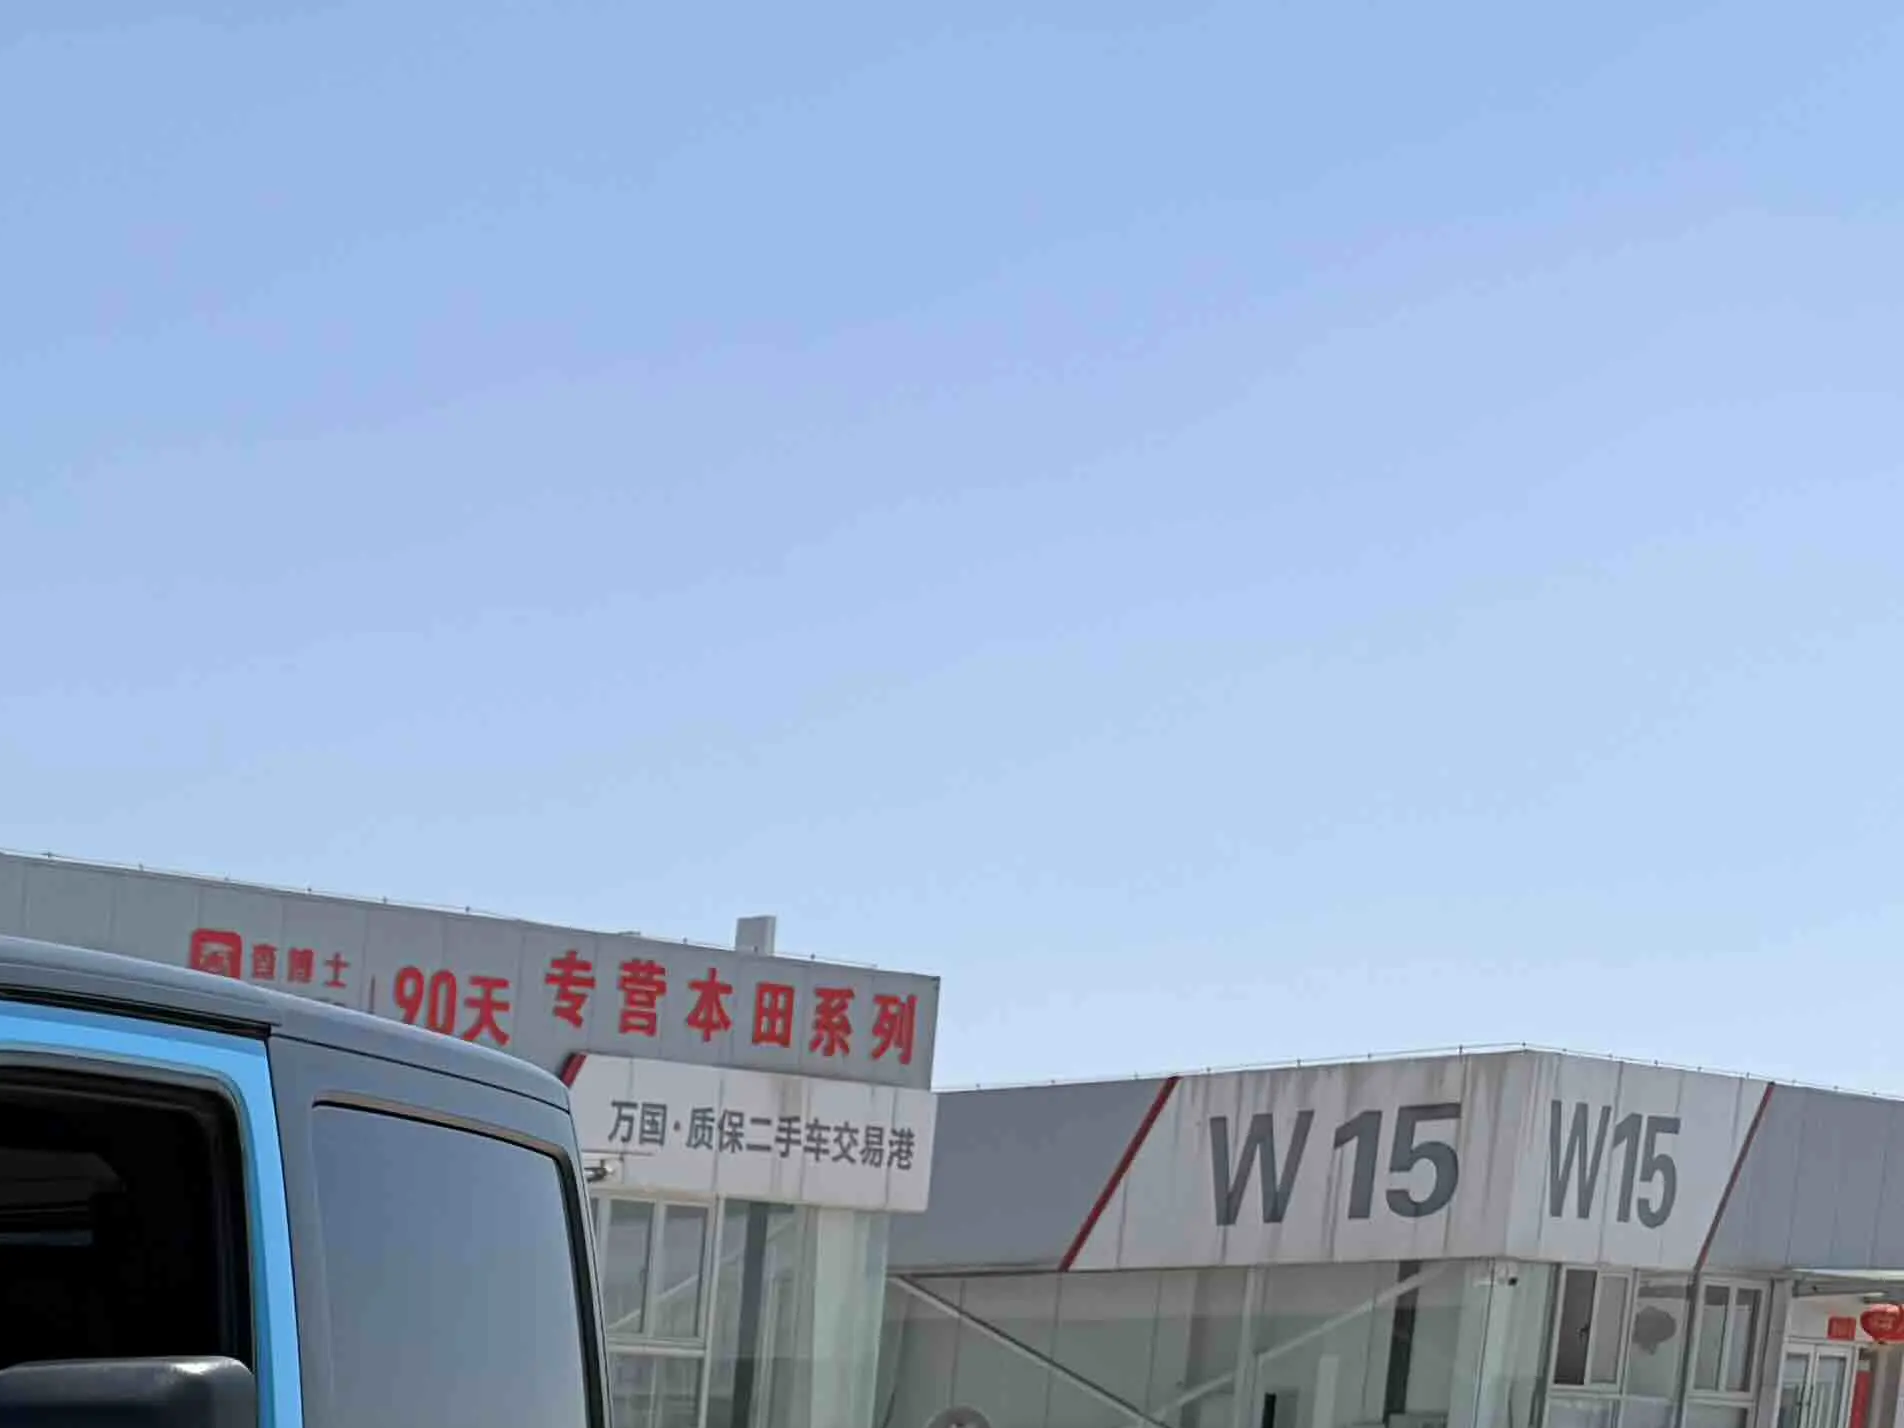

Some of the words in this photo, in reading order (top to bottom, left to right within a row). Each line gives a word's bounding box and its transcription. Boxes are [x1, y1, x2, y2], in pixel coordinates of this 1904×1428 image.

[545, 950, 919, 1065] 专营本田系列
[1209, 1102, 1462, 1226] W15
[1549, 1100, 1681, 1229] W15
